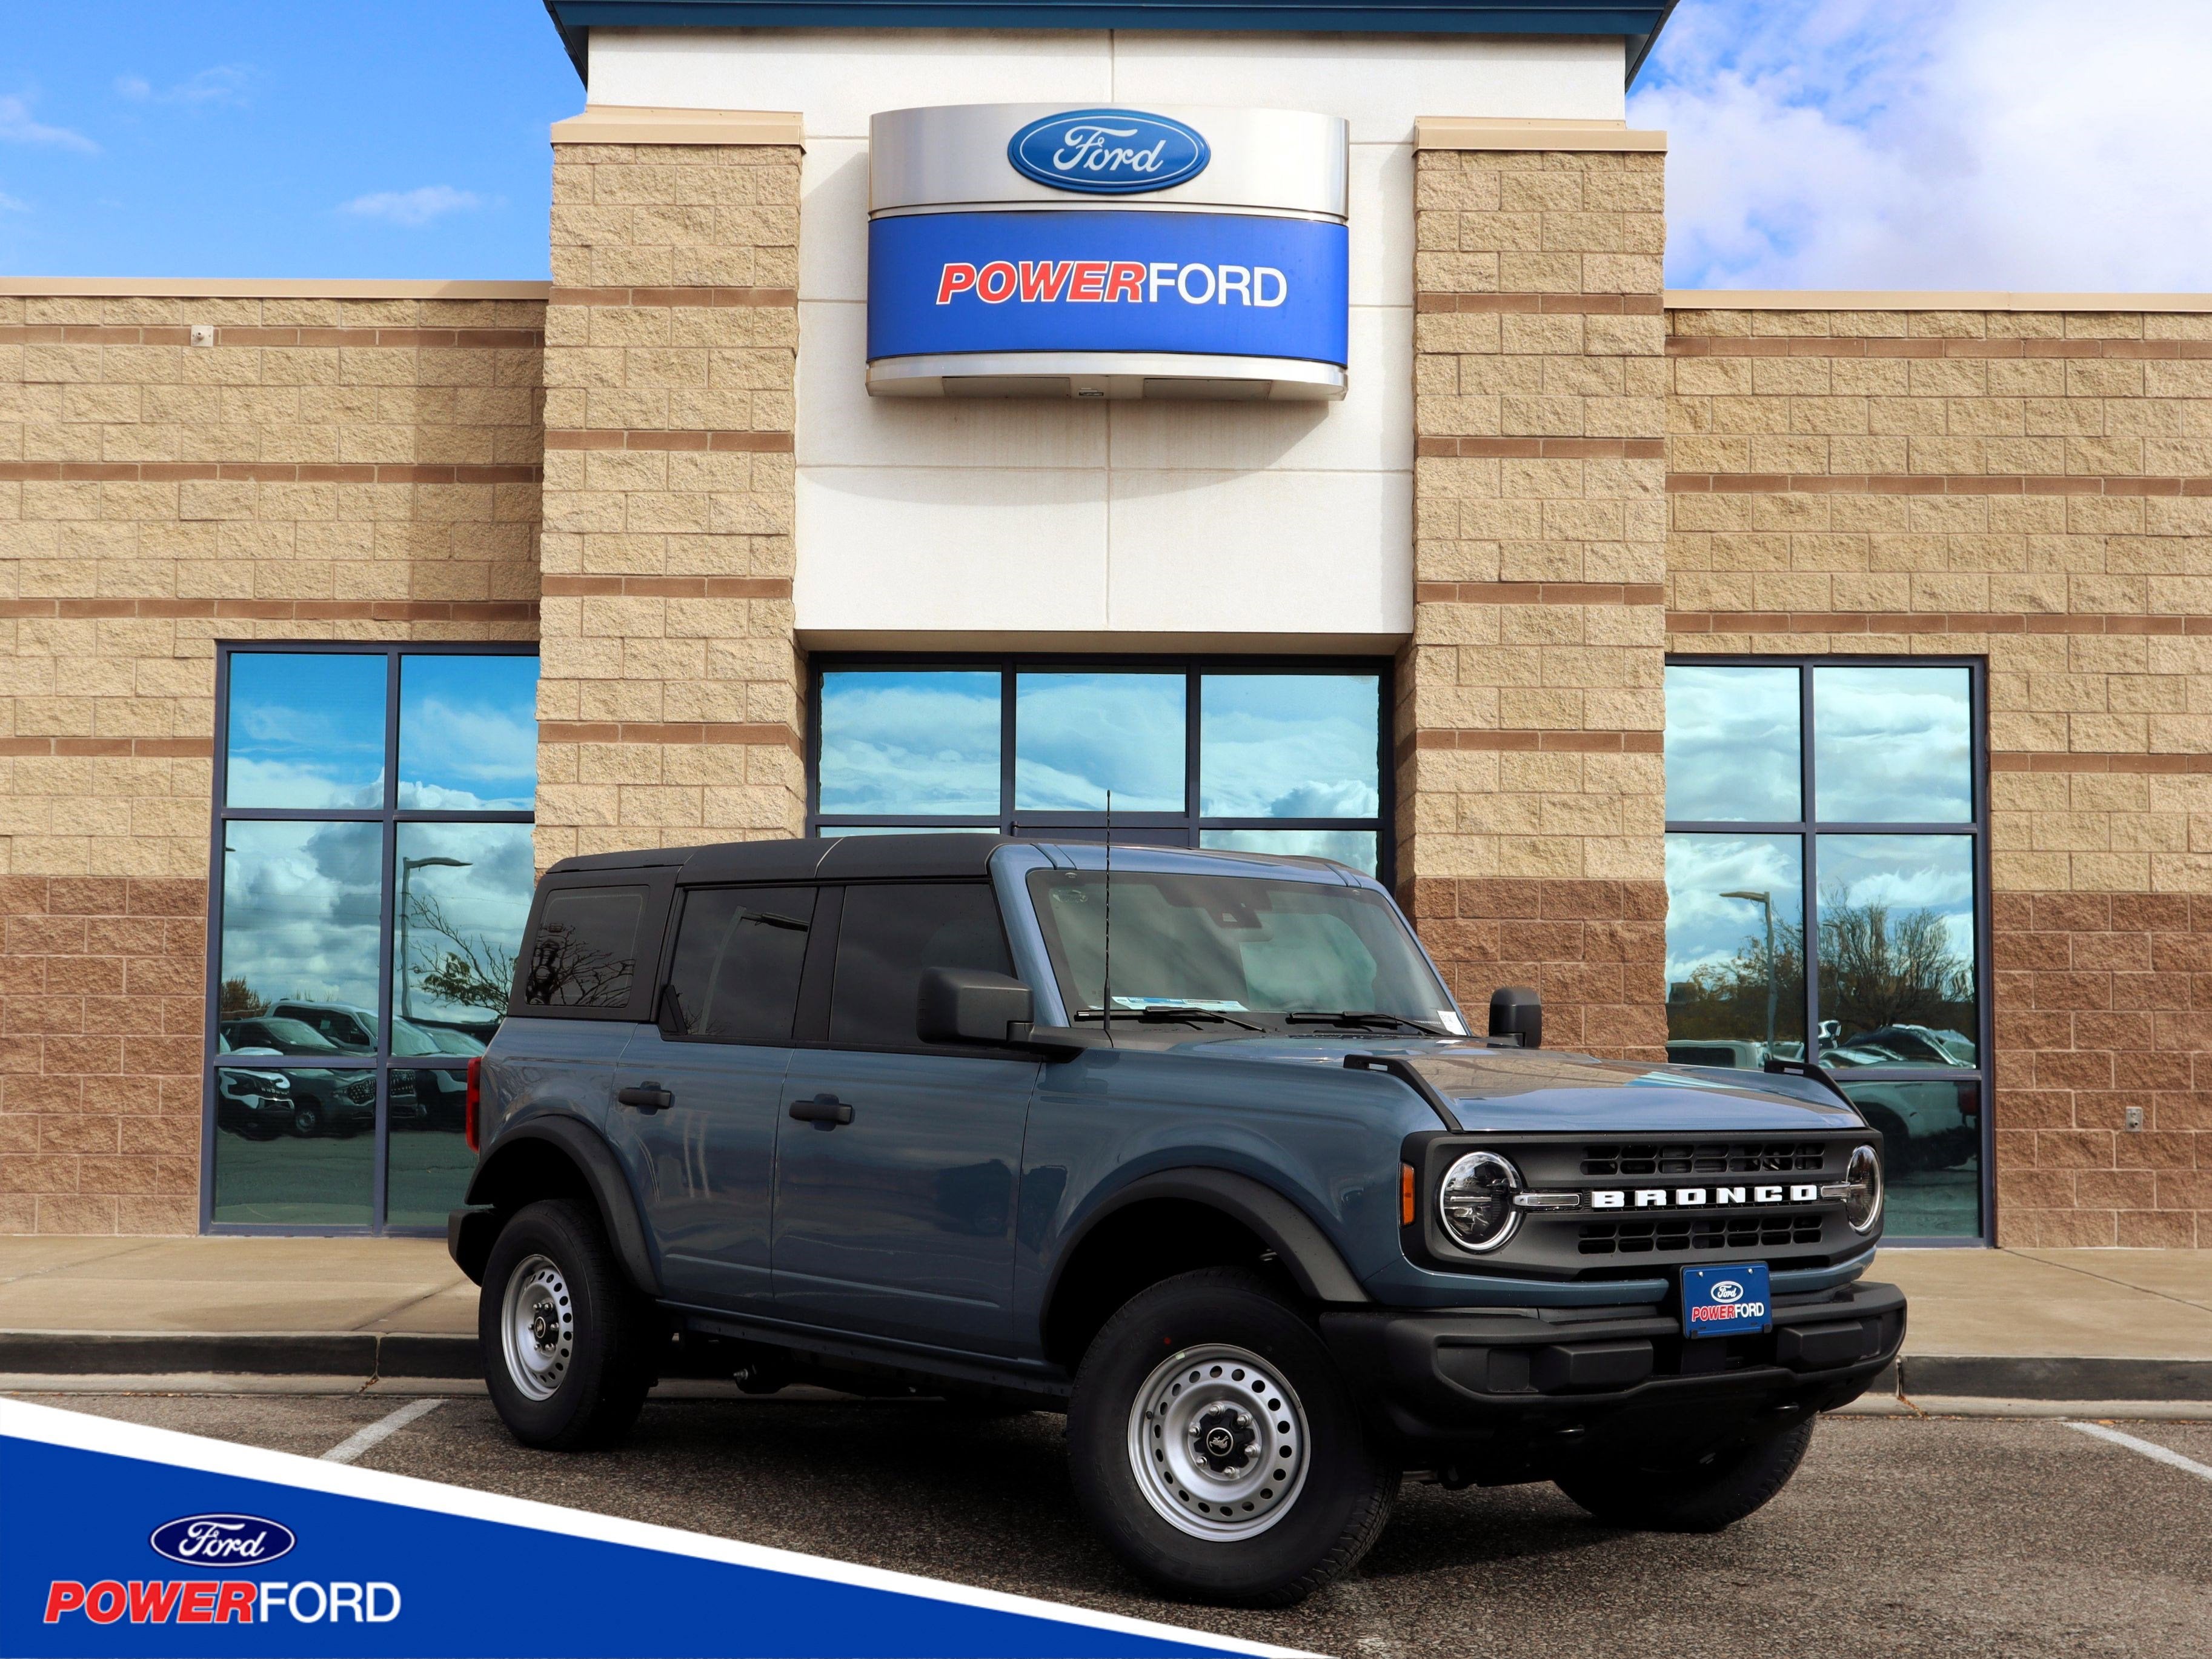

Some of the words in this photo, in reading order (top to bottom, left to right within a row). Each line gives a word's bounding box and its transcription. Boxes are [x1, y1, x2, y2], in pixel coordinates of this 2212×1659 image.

[1053, 125, 1166, 173] Ford
[1591, 1185, 1817, 1208] BRONCO
[1717, 1285, 1737, 1298] Ford
